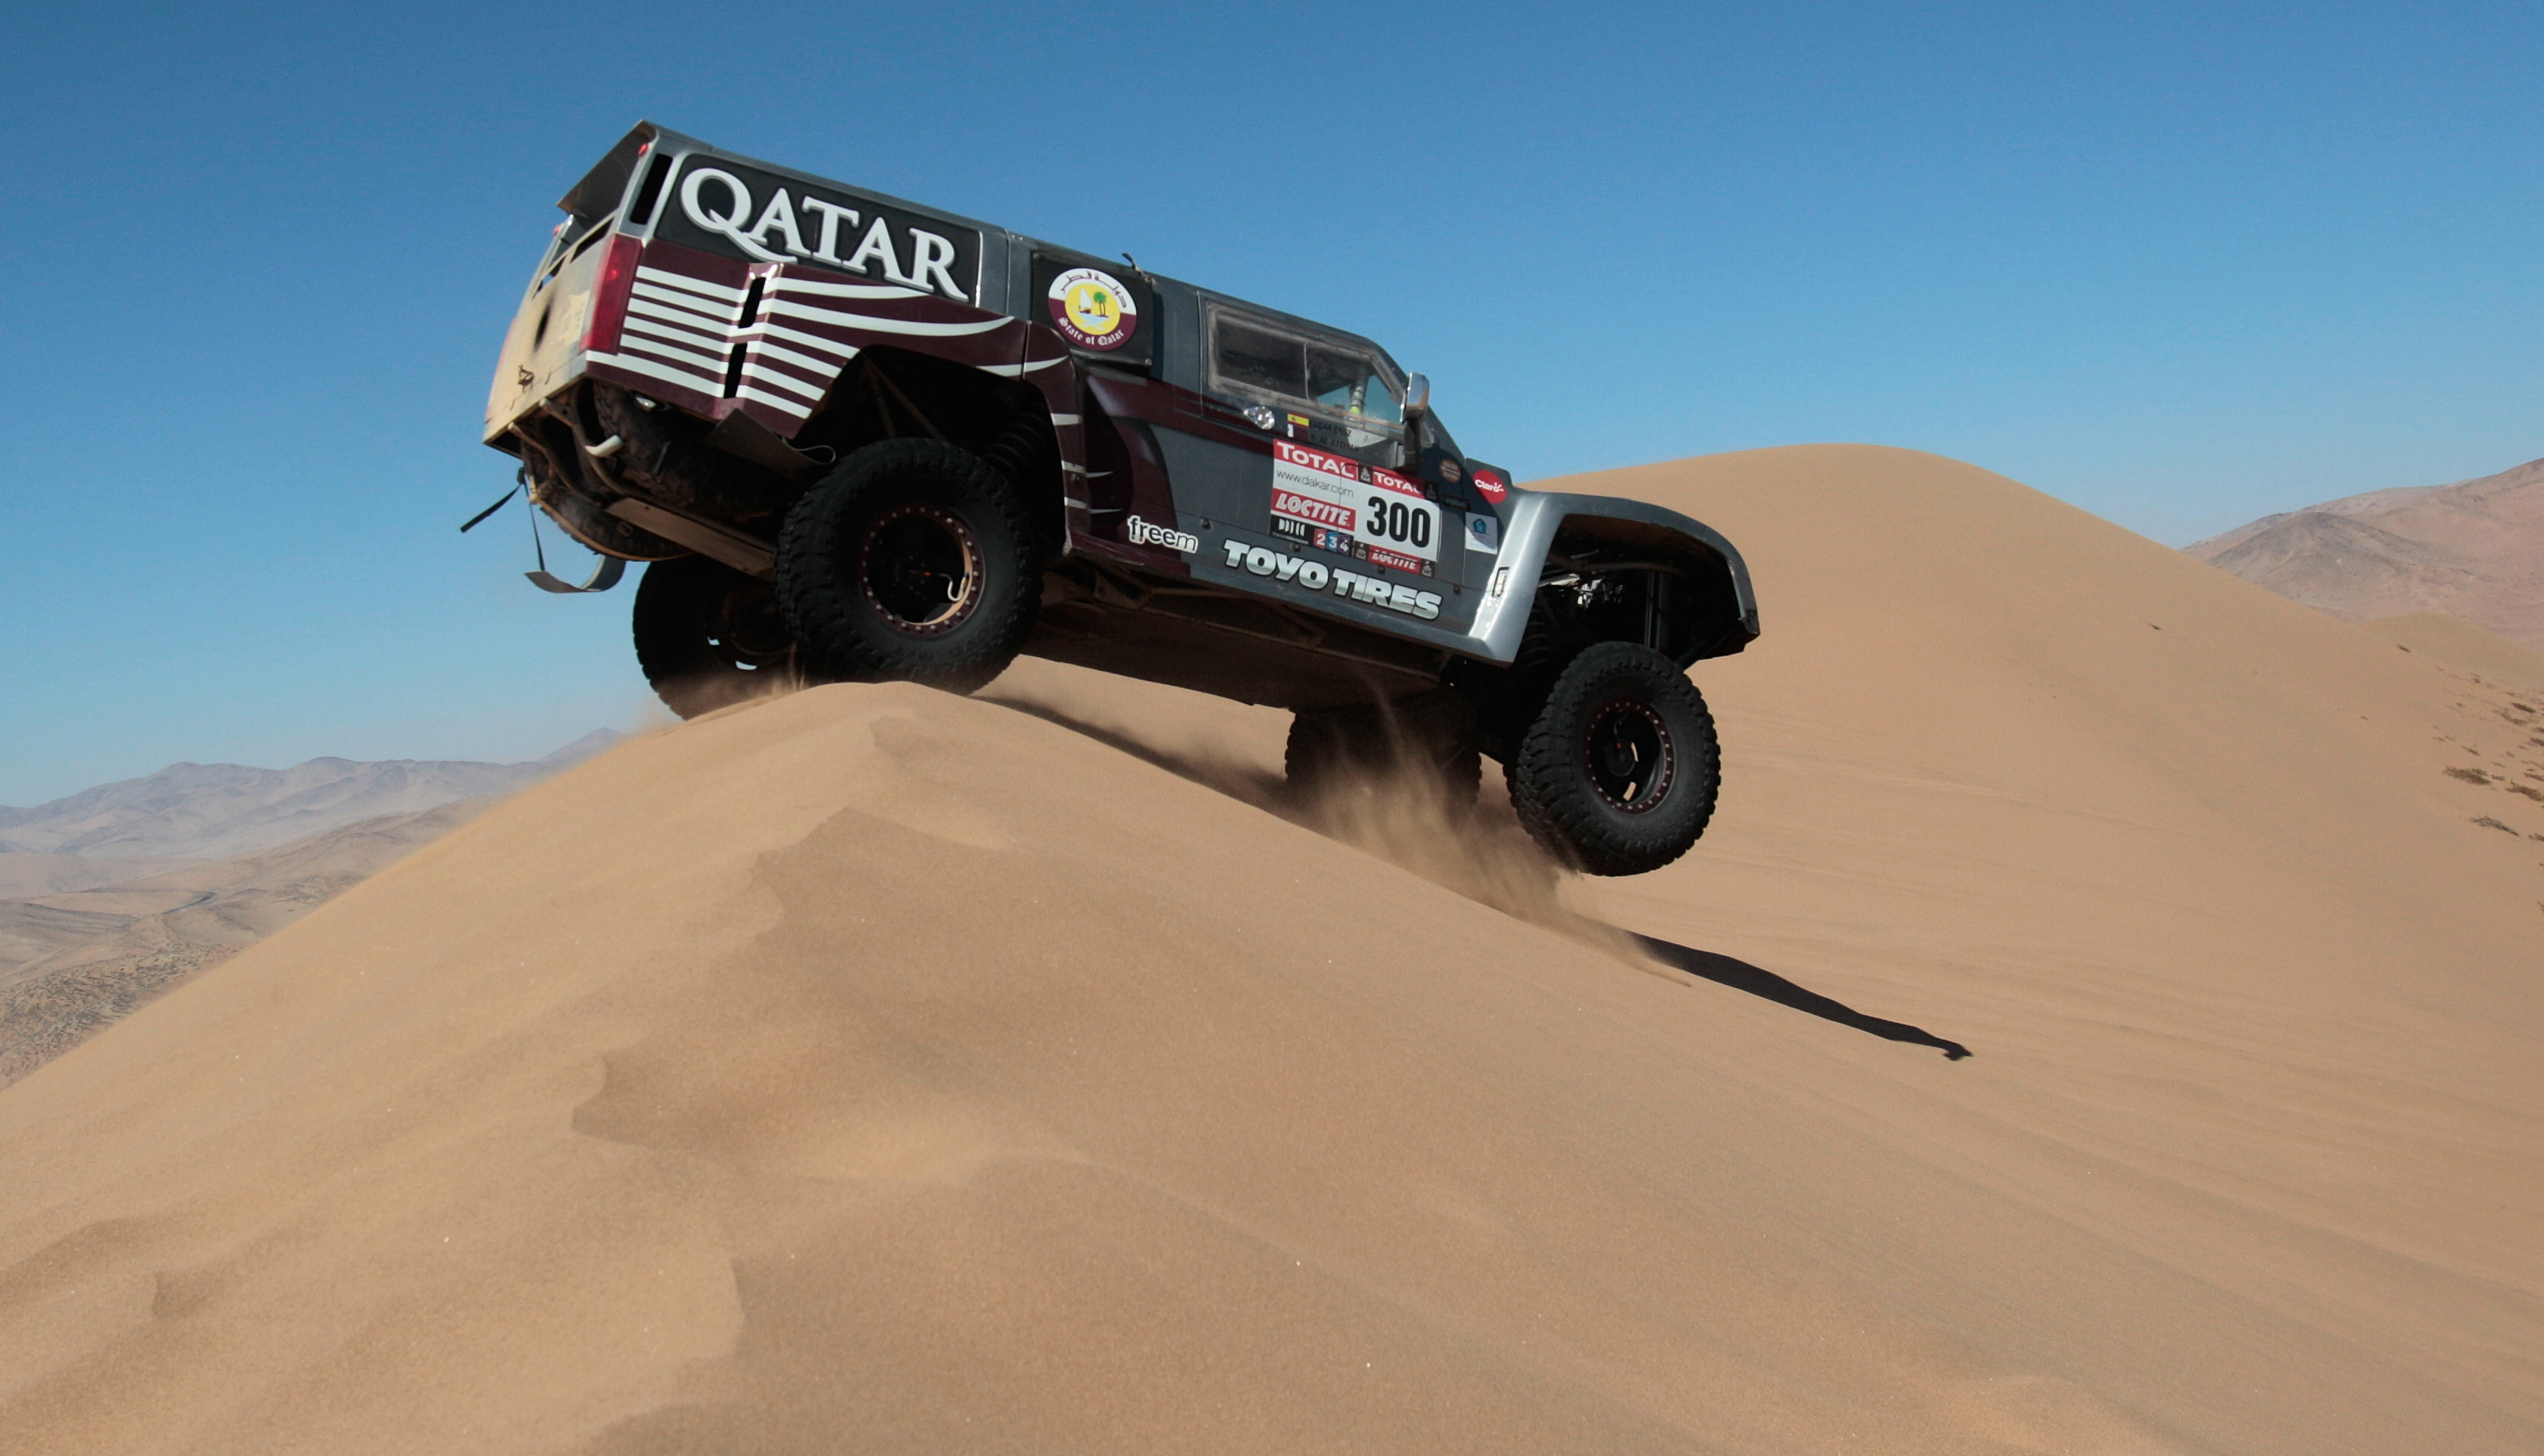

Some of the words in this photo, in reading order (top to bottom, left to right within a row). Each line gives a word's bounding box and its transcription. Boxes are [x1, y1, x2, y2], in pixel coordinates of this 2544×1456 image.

[680, 168, 968, 302] QATAR
[1058, 317, 1083, 341] State
[1085, 336, 1094, 345] of
[1098, 329, 1125, 346] Qatar
[1277, 442, 1354, 479] TOTAL
[1277, 469, 1354, 499] www.dakar.com
[1373, 471, 1422, 494] TOTAL
[1474, 479, 1499, 492] Claro
[1276, 493, 1351, 526] LOCTITE
[1366, 496, 1431, 548] 300
[1130, 517, 1196, 551] freem
[1317, 533, 1326, 546] 2
[1329, 536, 1338, 550] 3
[1339, 539, 1349, 552] 4
[1372, 550, 1417, 570] LOCTITE
[1224, 539, 1329, 589] TOYO
[1332, 568, 1442, 620] TIRES
